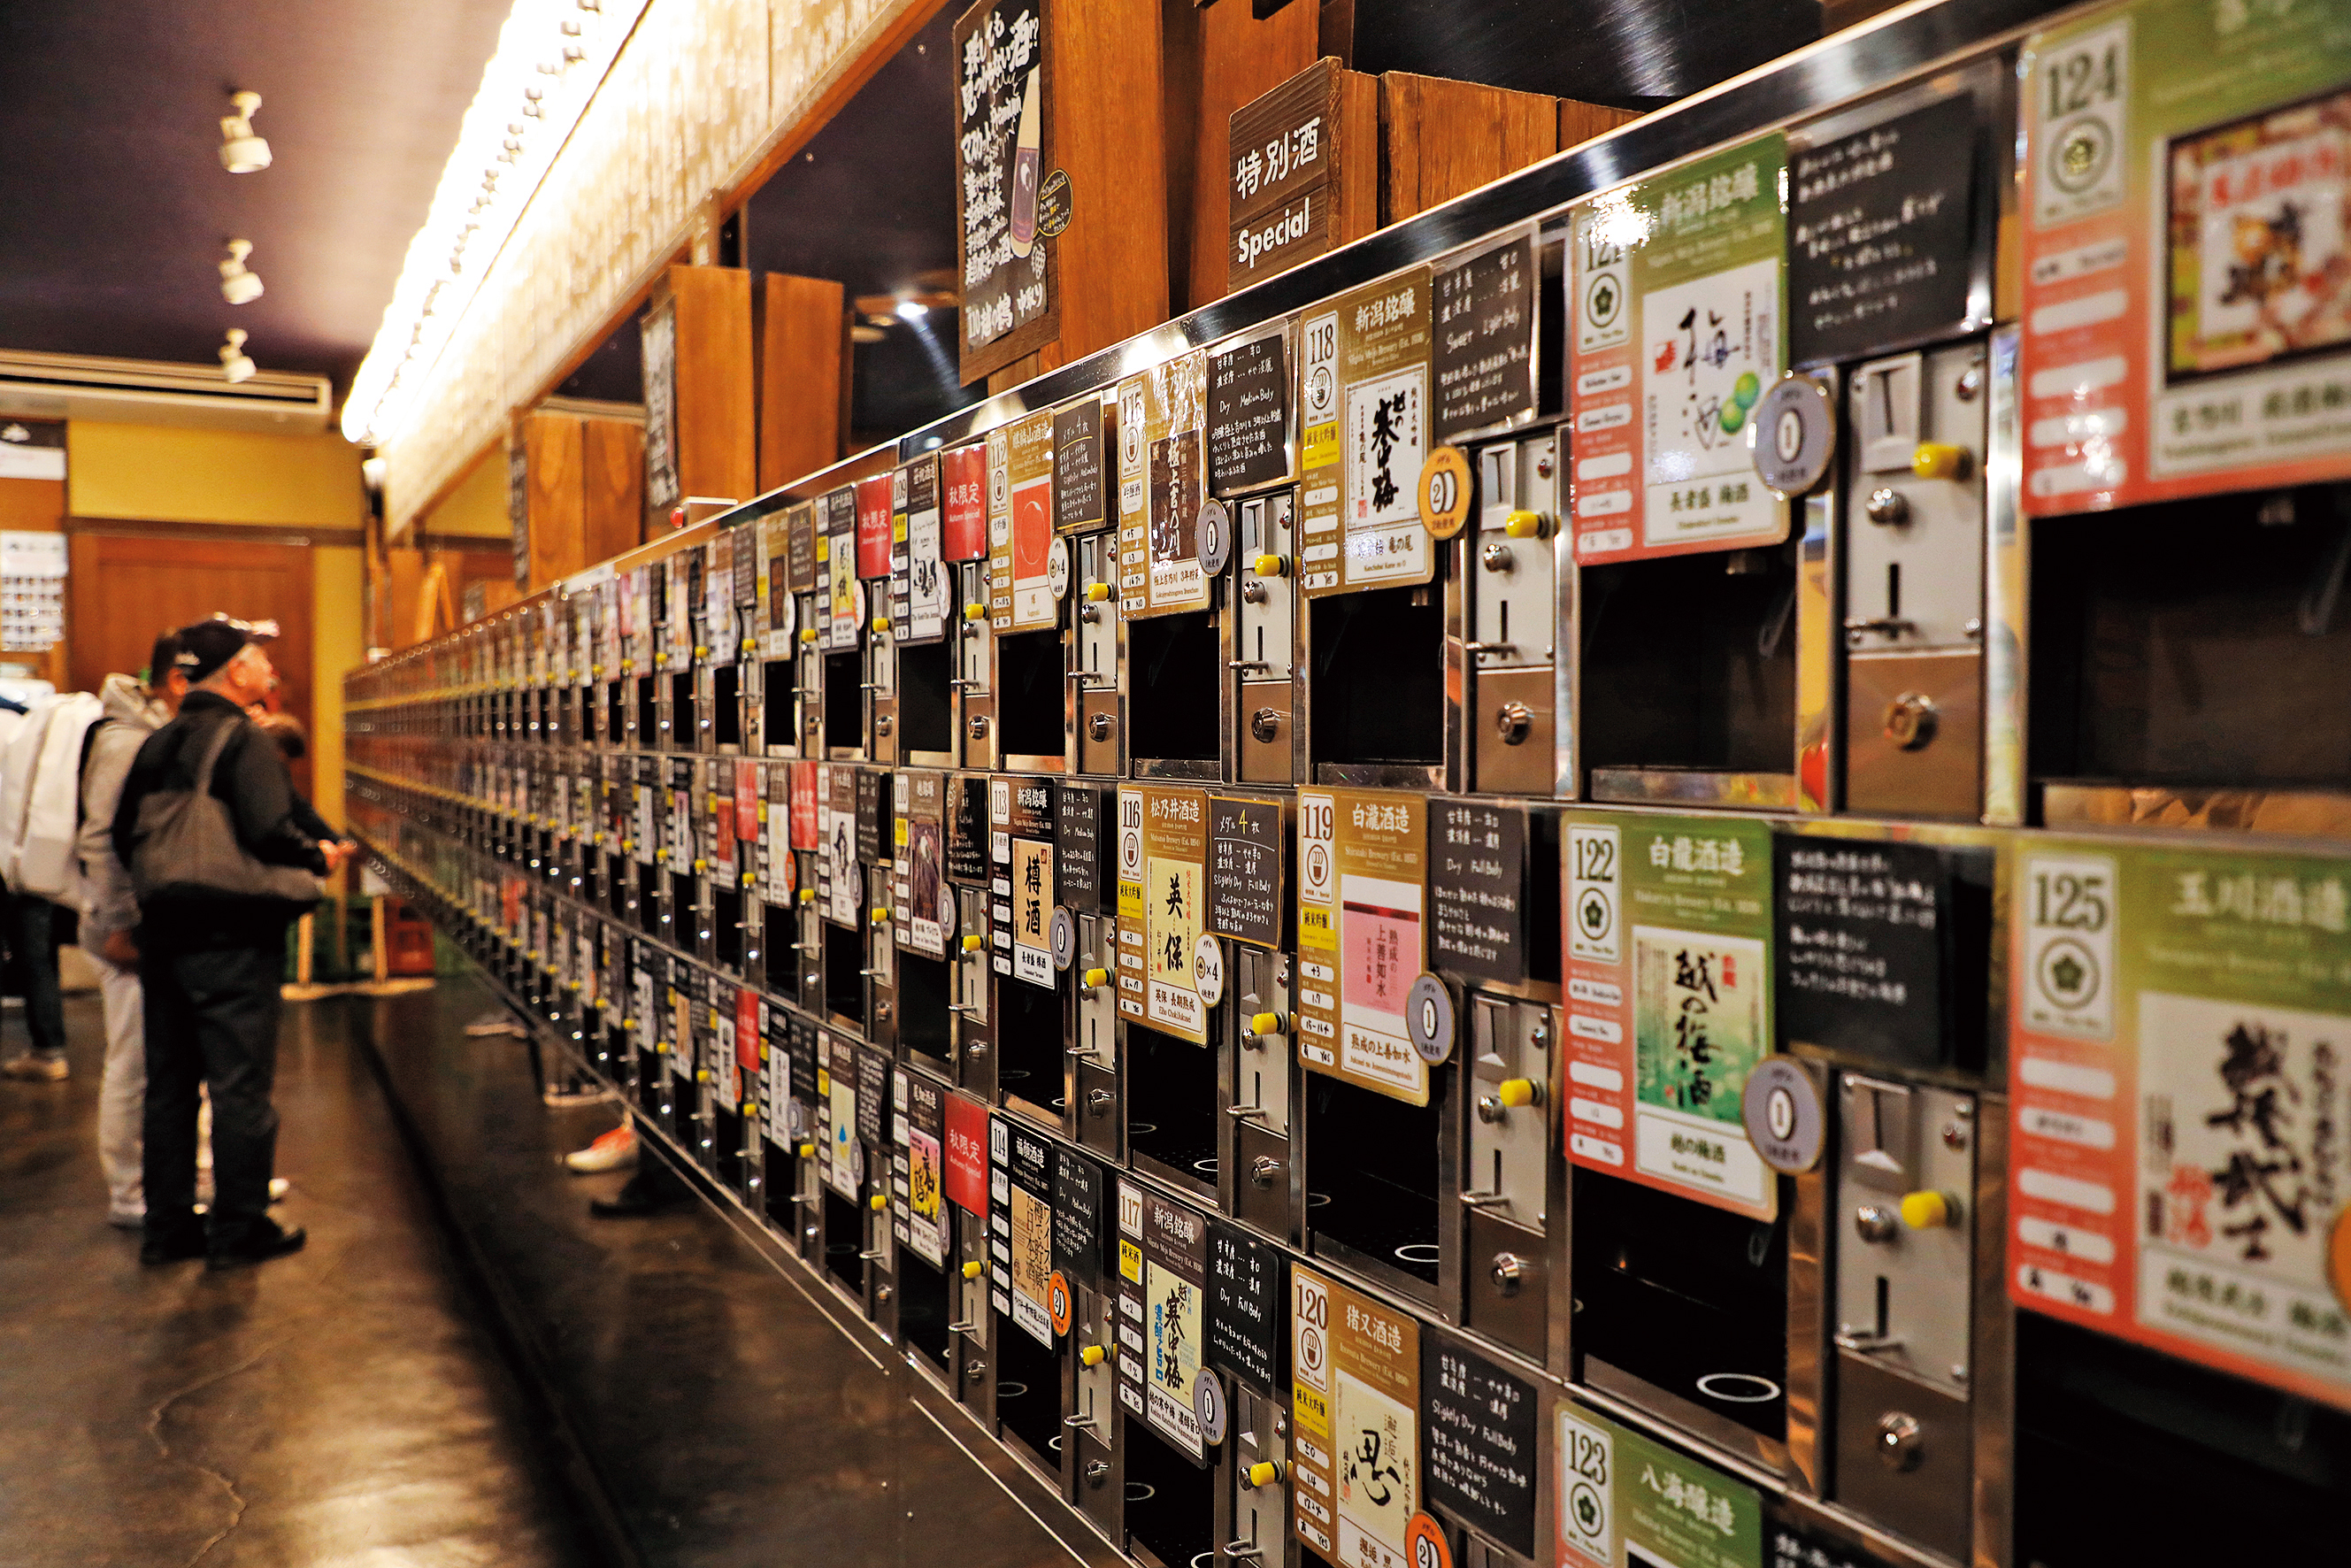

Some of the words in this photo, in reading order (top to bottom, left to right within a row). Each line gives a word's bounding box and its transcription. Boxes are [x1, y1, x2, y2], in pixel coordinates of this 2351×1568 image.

[2045, 41, 2119, 121] 124
[1236, 116, 1320, 200] 特別酒
[1237, 197, 1310, 269] Special
[1356, 288, 1416, 334] 新潟銘醸
[1310, 324, 1333, 365] 118
[1447, 329, 1474, 355] Sweet
[1217, 354, 1233, 370] 甘辛度
[1249, 345, 1261, 357] 辛口
[1217, 371, 1234, 388] 濃淡度
[1219, 401, 1231, 416] Dry
[1240, 391, 1259, 408] Medium
[1260, 388, 1274, 402] Body
[1306, 424, 1336, 447] 純米大吟醸
[992, 441, 1006, 469] 112
[895, 479, 907, 501] 109
[949, 481, 980, 507] 秋限定
[1124, 480, 1141, 498] 吟醸酒
[1433, 483, 1441, 504] 2
[964, 508, 980, 519] Special
[1208, 507, 1217, 516] メダル
[1127, 529, 1134, 538] +5
[1210, 531, 1214, 546] 1
[1388, 535, 1413, 554] 亀の尾
[1205, 559, 1219, 568] 1枚使用
[1154, 573, 1178, 586] 極上吉乃川
[1136, 600, 1143, 609] NO
[995, 790, 1007, 815] 113
[1018, 787, 1048, 809] 新潟銘醸
[1150, 796, 1200, 823] 松乃井酒造
[1123, 800, 1140, 828] 116
[1302, 804, 1333, 842] 119
[1352, 803, 1410, 834] 白瀧酒造
[1218, 841, 1233, 856] 甘辛度
[1243, 846, 1261, 861] やや辛口
[1576, 838, 1614, 883] 122
[1649, 835, 1745, 876] 白龍酒造
[1217, 857, 1233, 871] 濃淡度
[1245, 861, 1256, 875] 濃厚
[1447, 857, 1462, 876] Dry
[1119, 884, 1141, 899] 純米大吟醸
[1214, 874, 1233, 888] Slightly
[1025, 853, 1041, 936] 樽酒
[2034, 872, 2108, 935] 125
[1164, 872, 1183, 972] 英保
[1304, 911, 1328, 928] 純米吟醸
[1376, 925, 1387, 997] 上善如水
[1388, 929, 1398, 972] 熟成の
[1310, 965, 1321, 977] +3
[1156, 988, 1167, 1003] 英保
[1171, 993, 1195, 1013] 長期熟成
[1202, 988, 1215, 1000] 4枚使用
[1424, 983, 1436, 993] メダル
[1426, 1010, 1432, 1029] 1
[1350, 1034, 1411, 1064] 熟成の上善如水
[895, 1081, 905, 1103] 111
[949, 1129, 980, 1164] 秋限定
[994, 1128, 1006, 1157] 114
[1016, 1136, 1044, 1169] 福顔酒造
[1121, 1195, 1140, 1229] 117
[1155, 1203, 1195, 1244] 新潟銘醸
[1122, 1243, 1140, 1264] 純米酒
[1218, 1240, 1235, 1260] 甘辛度
[1250, 1257, 1260, 1272] 辛口
[1216, 1258, 1234, 1280] 濃淡度
[1055, 1295, 1058, 1307] 2
[1220, 1287, 1231, 1306] Dry
[1238, 1295, 1248, 1312] Full
[1248, 1303, 1262, 1322] Body
[1297, 1284, 1328, 1331] 120
[1164, 1287, 1186, 1390] 寒中梅
[1347, 1304, 1402, 1355] 猪又酒造
[1203, 1376, 1213, 1387] メダル
[1124, 1388, 1129, 1402] 有
[1206, 1397, 1211, 1414] 1
[1296, 1388, 1325, 1418] 純米大吟醸
[1149, 1390, 1176, 1419] 越の寒中梅
[1178, 1410, 1201, 1435] 濃醇旨口
[1568, 1428, 1607, 1487] 123
[1318, 1533, 1328, 1549] Yes
[1418, 1544, 1426, 1565] 2
